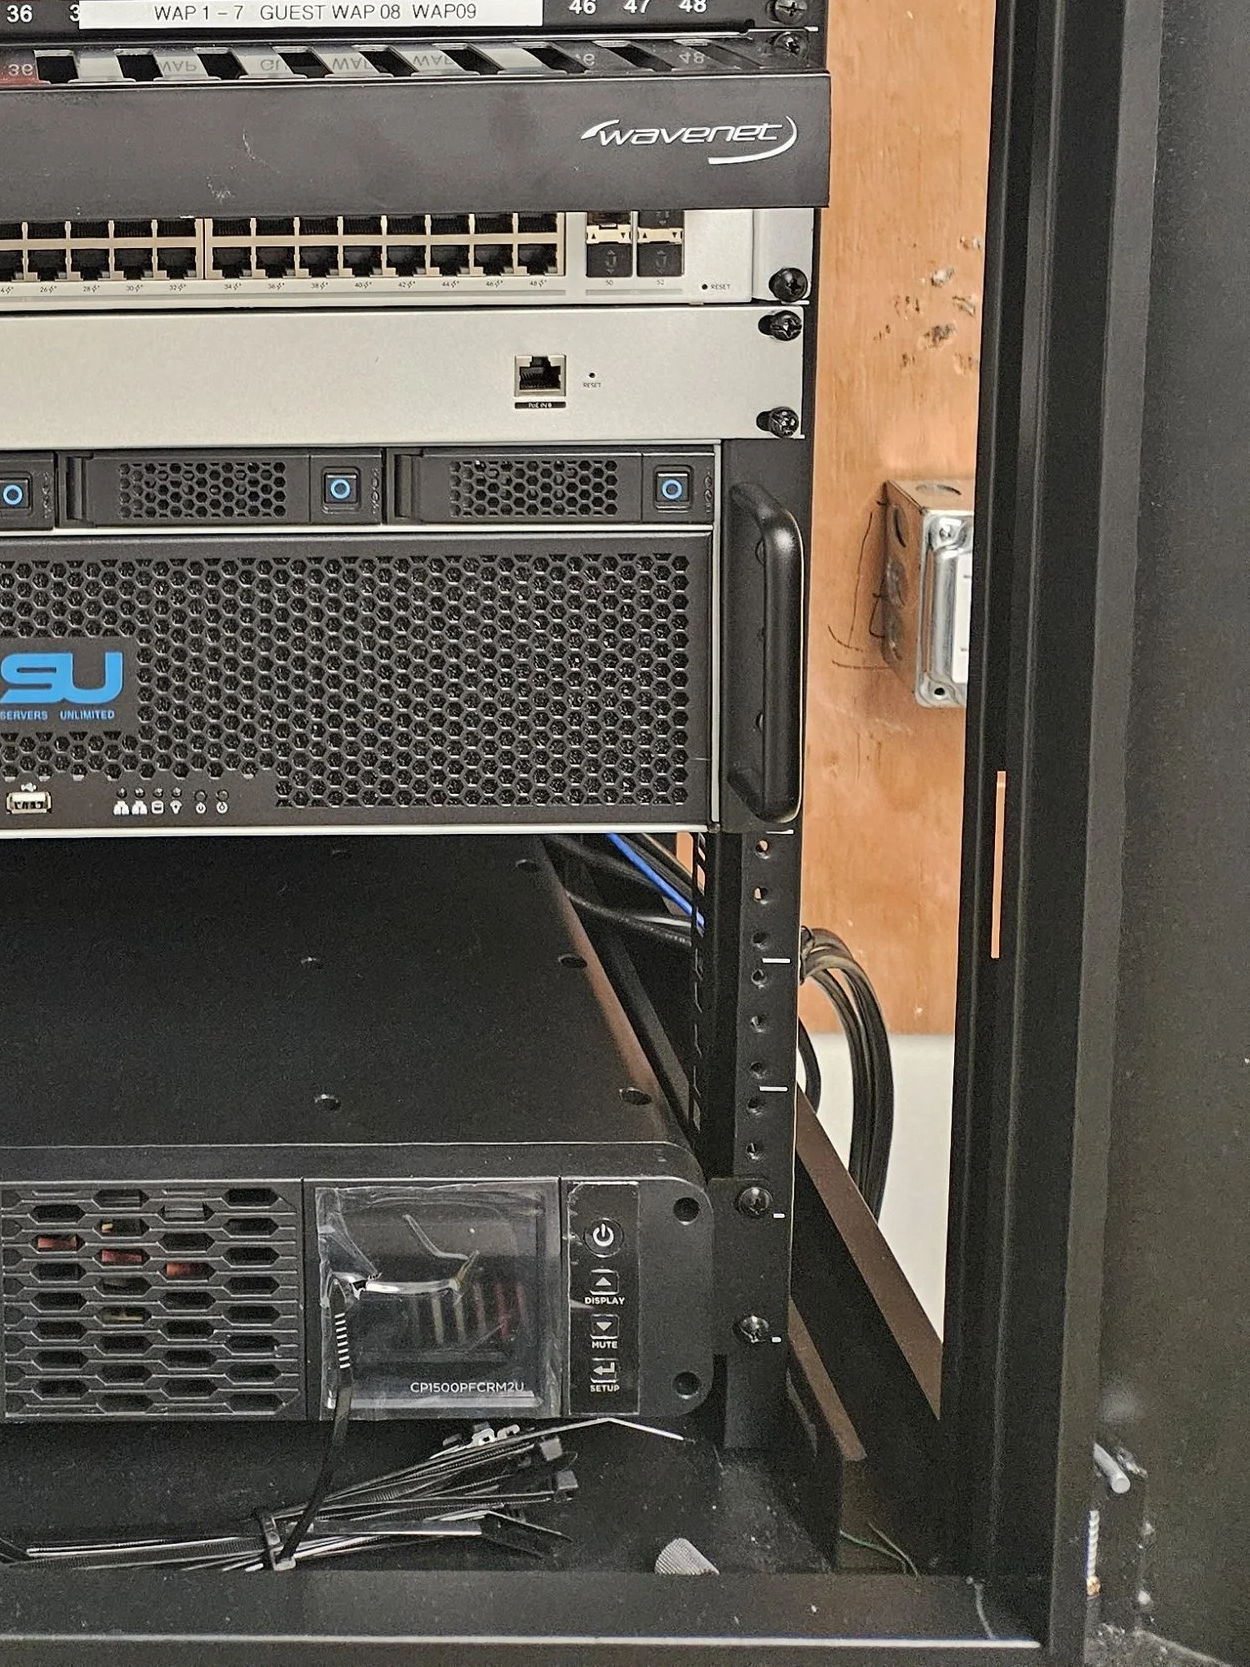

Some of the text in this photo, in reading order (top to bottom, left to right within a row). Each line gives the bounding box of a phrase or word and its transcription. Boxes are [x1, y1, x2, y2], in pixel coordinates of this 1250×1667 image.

[6, 4, 33, 23] 36
[69, 4, 80, 22] 3
[154, 5, 197, 21] WAP
[202, 5, 209, 21] 1
[234, 5, 244, 20] 7
[260, 4, 327, 21] GUEST
[332, 4, 376, 21] WAP
[380, 4, 401, 20] 08
[413, 3, 477, 20] WAP09
[586, 120, 790, 154] wavenet
[0, 652, 123, 704] SU
[0, 709, 115, 721] SERVERS UNLIMITED
[584, 1296, 625, 1306] DISPLAY
[591, 1340, 618, 1349] MUTE
[410, 1381, 525, 1394] CP1500PFCRM2U
[590, 1384, 620, 1393] SETUP
